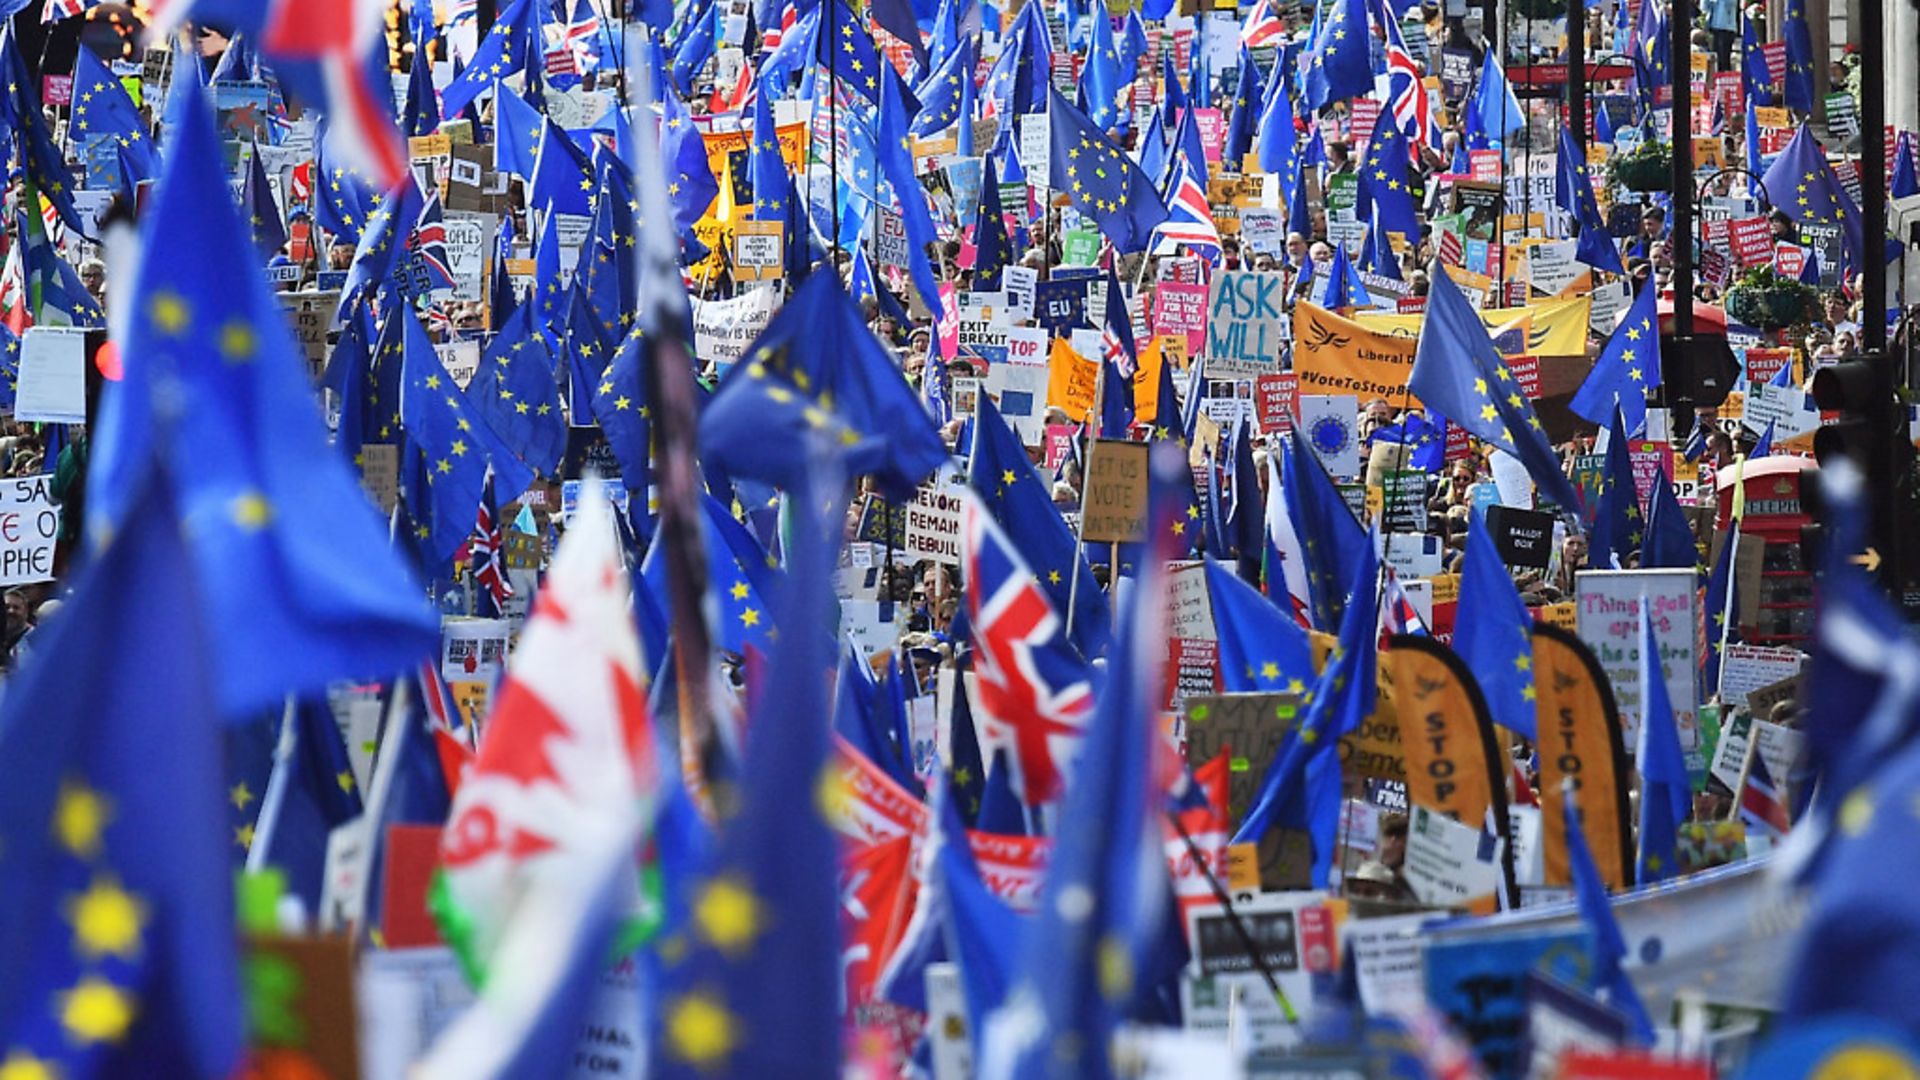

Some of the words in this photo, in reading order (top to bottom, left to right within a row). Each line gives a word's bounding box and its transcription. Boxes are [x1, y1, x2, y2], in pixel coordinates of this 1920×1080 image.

[884, 218, 904, 236] EU
[1213, 273, 1279, 320] ASK
[1049, 299, 1071, 317] EU
[959, 321, 989, 333] EXIT
[959, 333, 1007, 345] BREXIT
[1209, 321, 1274, 362] WILL
[1008, 340, 1038, 357] TOP
[1357, 348, 1403, 365] Liberal
[1261, 380, 1297, 392] GREEN
[1267, 392, 1293, 403] NEW
[1120, 458, 1138, 479] US
[1576, 458, 1592, 469] LET
[1092, 482, 1133, 509] VOTE
[1509, 527, 1543, 538] BALLOT
[1513, 538, 1535, 549] BOX
[1580, 592, 1639, 617] Thing
[1608, 616, 1671, 640] apat
[1179, 667, 1213, 677] BRING
[1178, 677, 1213, 688] DOWN
[1425, 711, 1456, 803] STOP
